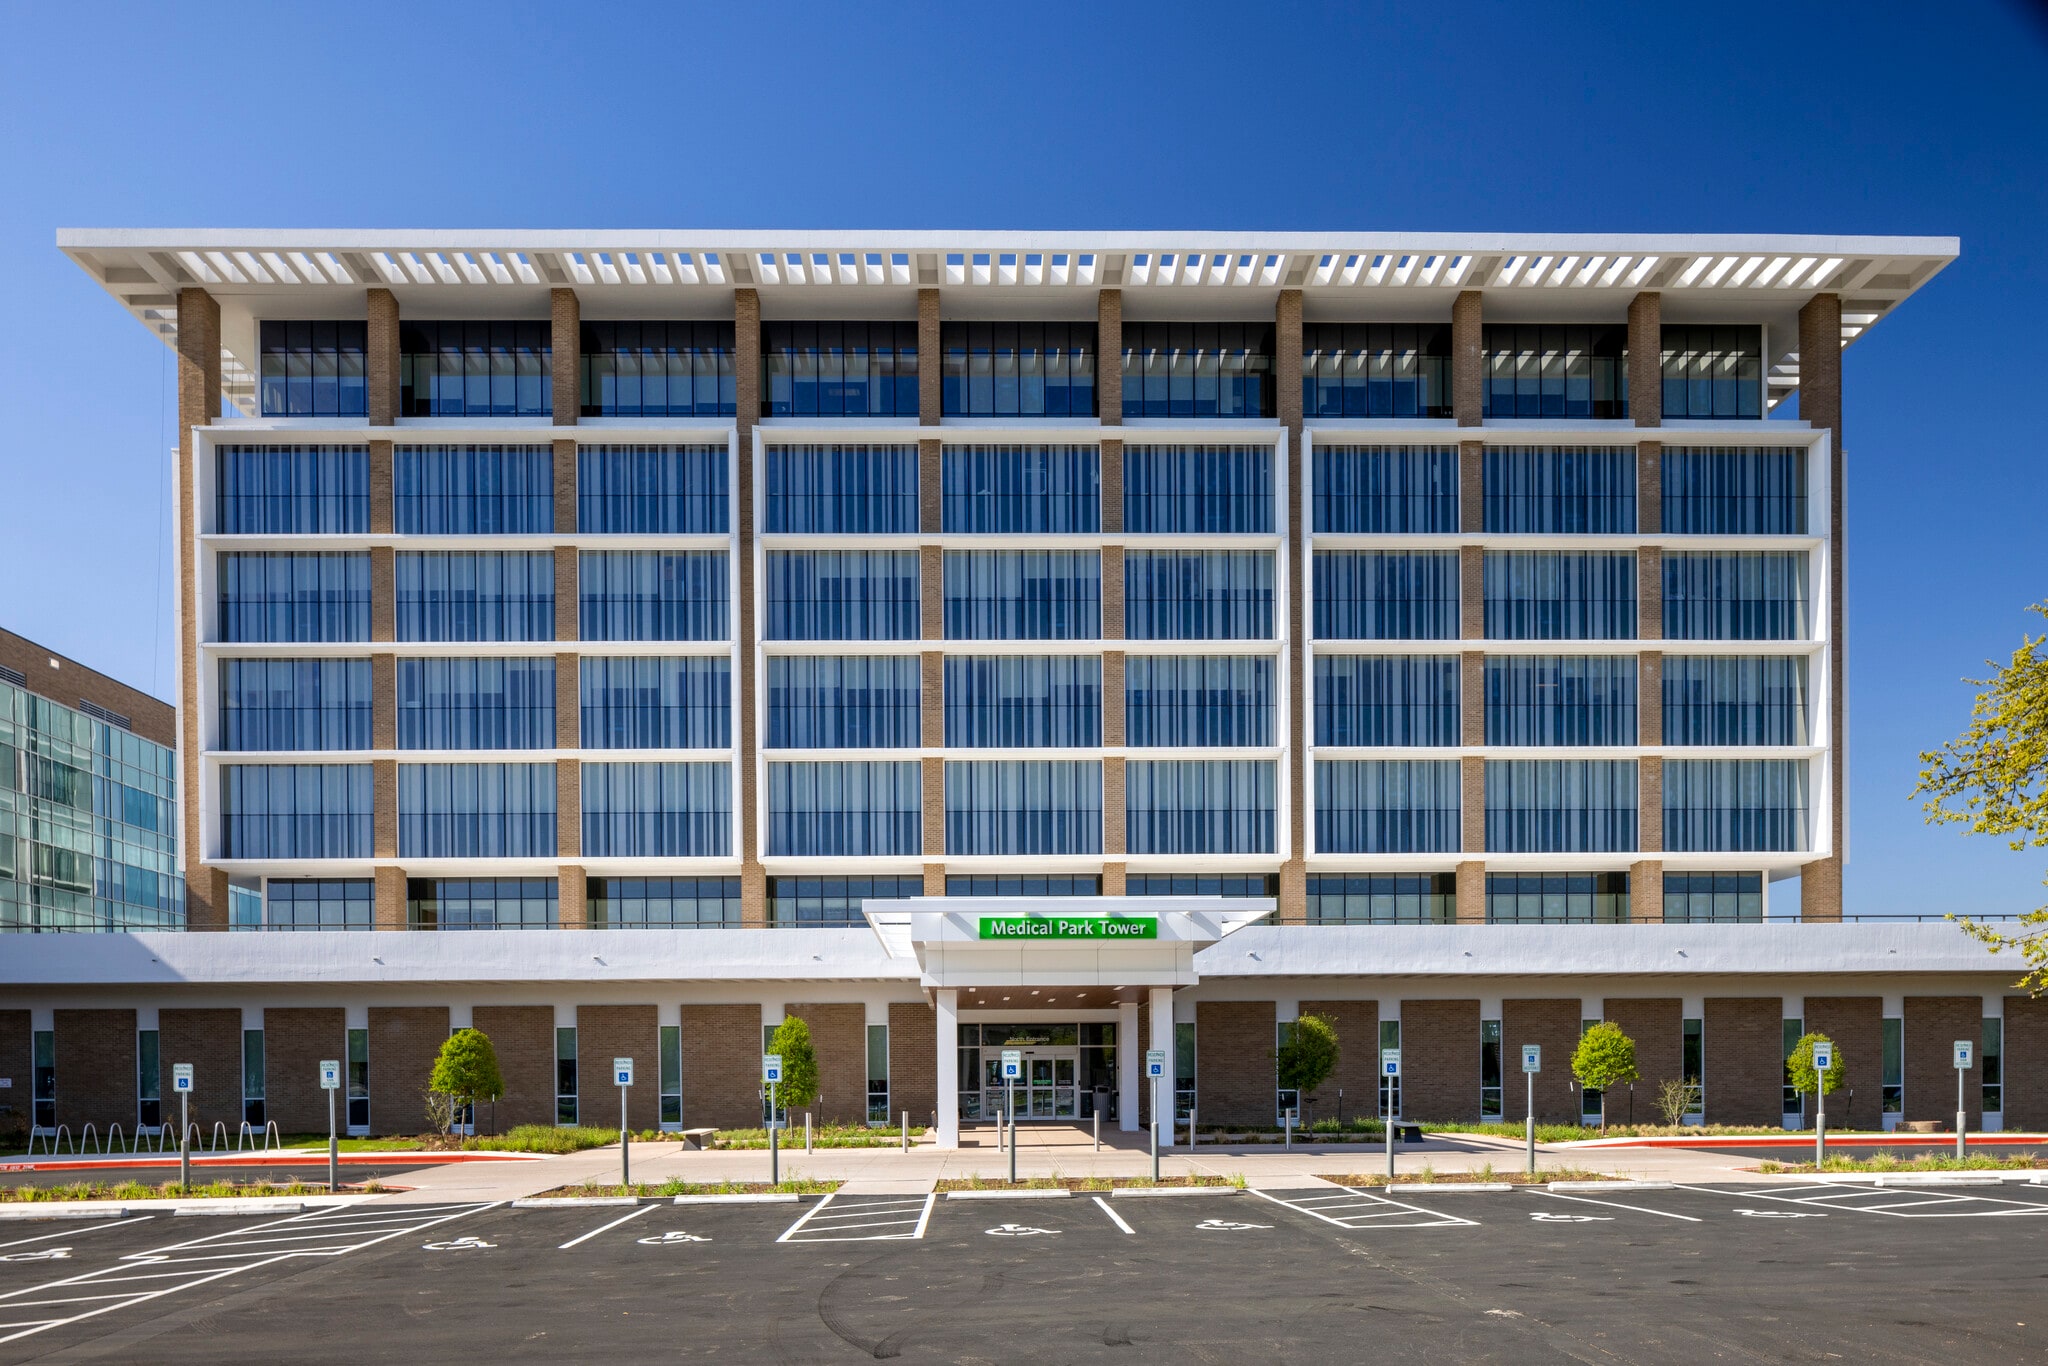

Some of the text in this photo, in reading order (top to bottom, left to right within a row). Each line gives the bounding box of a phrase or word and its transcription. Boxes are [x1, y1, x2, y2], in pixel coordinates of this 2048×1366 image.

[991, 920, 1147, 935] Medical Park Tower
